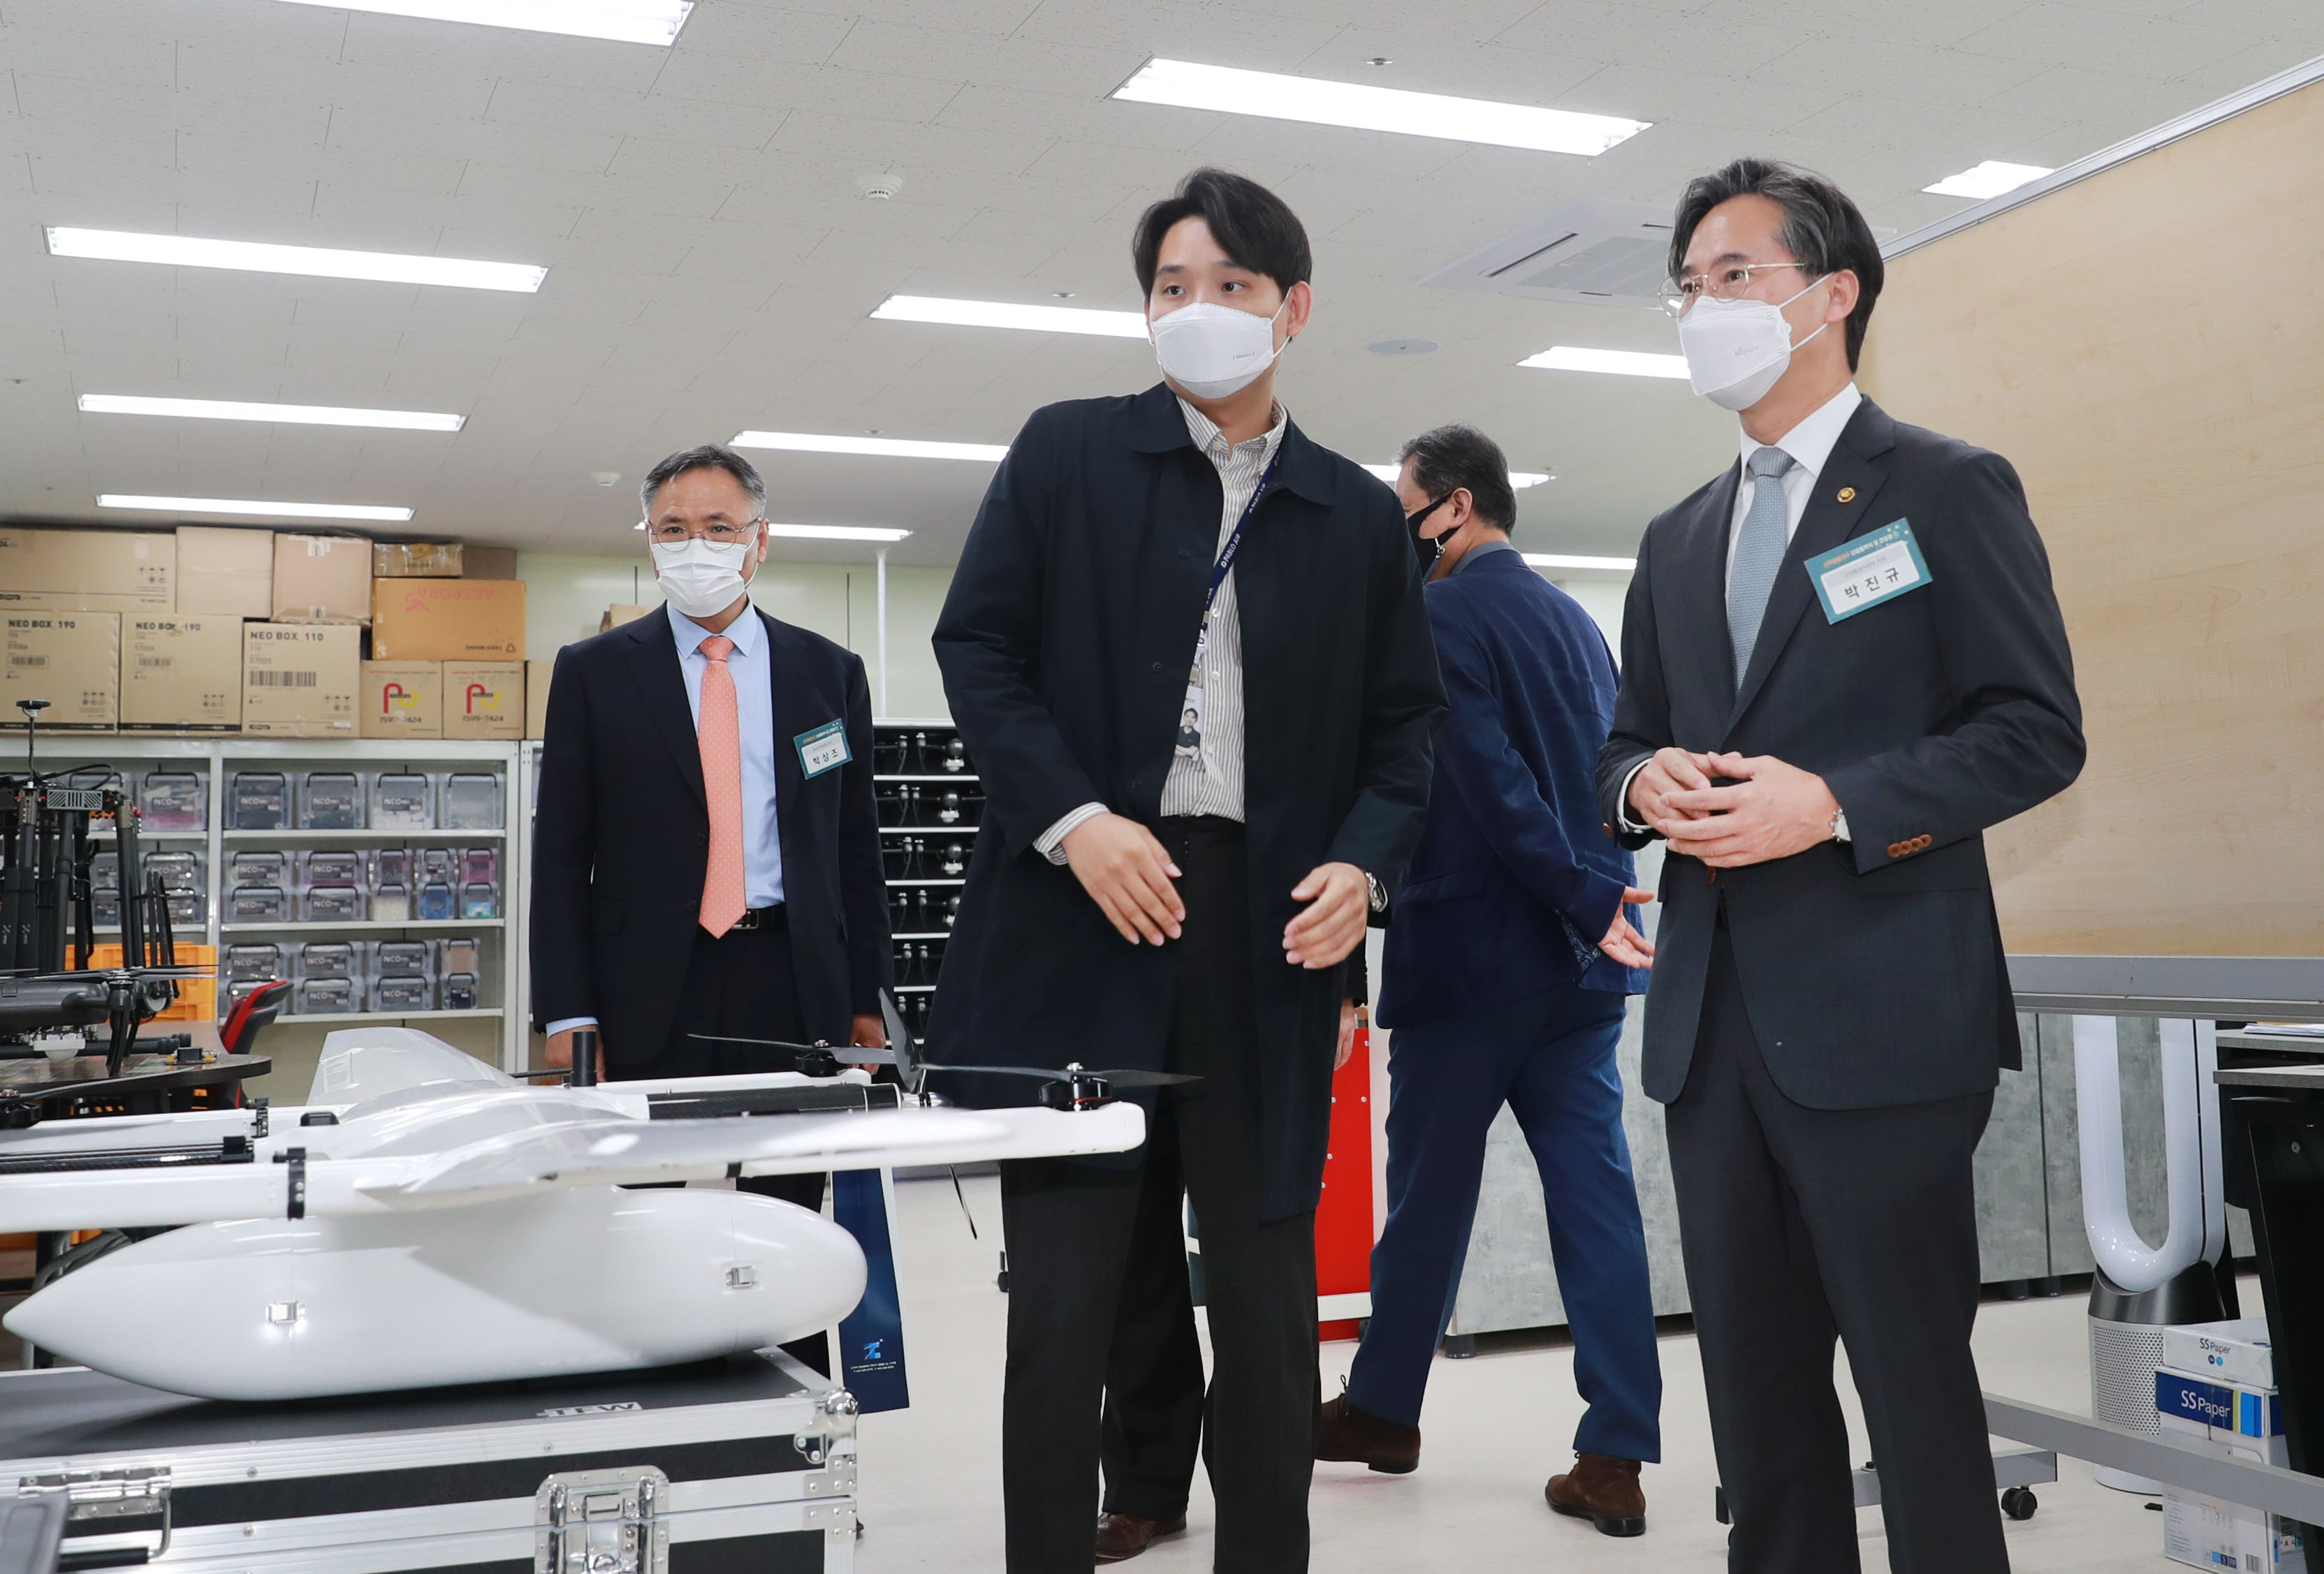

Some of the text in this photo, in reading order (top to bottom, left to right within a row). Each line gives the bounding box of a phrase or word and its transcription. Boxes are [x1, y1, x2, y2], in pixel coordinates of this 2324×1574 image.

[1223, 543, 1236, 563] PABLO
[1843, 567, 1899, 598] 박진규
[8, 619, 76, 629] NEO BOX 190
[249, 631, 324, 642] NEO BOX 110
[812, 749, 839, 765] 박상조
[2180, 1390, 2230, 1418] SSPaper
